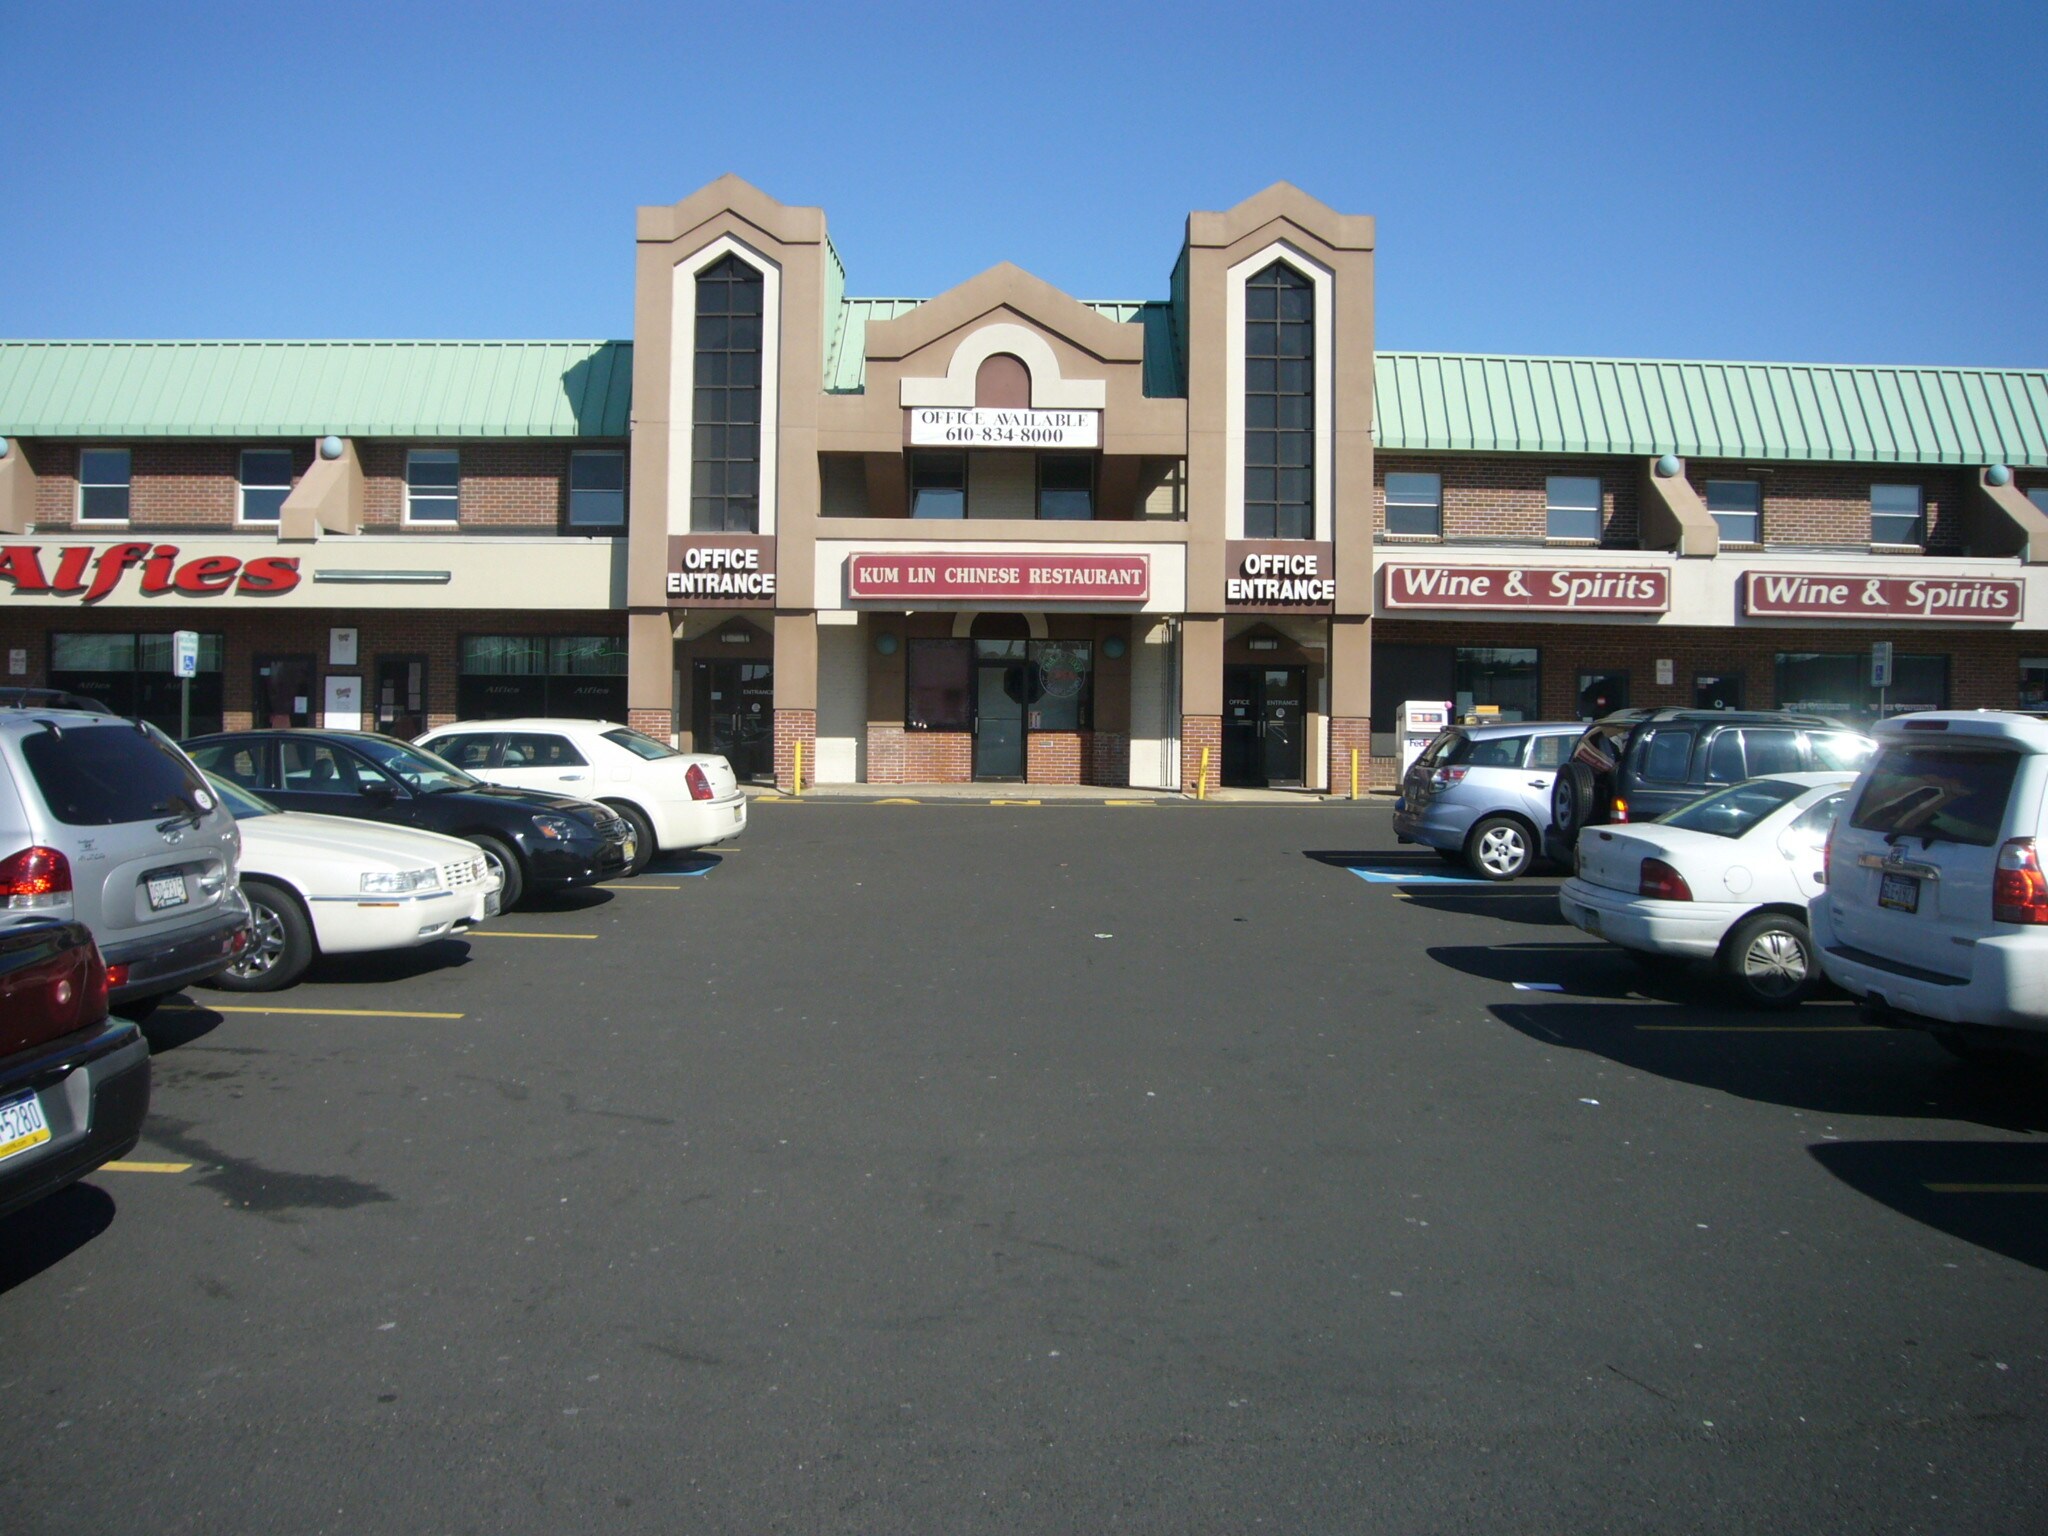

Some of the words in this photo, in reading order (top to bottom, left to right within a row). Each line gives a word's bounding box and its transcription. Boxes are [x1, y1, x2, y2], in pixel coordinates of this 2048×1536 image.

[922, 411, 986, 426] OFFICE
[993, 413, 1089, 428] AVAILABLE
[945, 427, 1064, 443] 610-834-8000
[684, 548, 759, 570] OFFICE
[1244, 553, 1318, 576] OFFICE
[0, 542, 301, 602] Alfies
[859, 566, 899, 584] KUM
[908, 567, 936, 584] LIN
[944, 567, 1020, 585] CHINESE
[1028, 568, 1143, 586] RESTAURANT
[666, 572, 777, 595] ENTRANCE
[1227, 578, 1335, 600] ENTRANCE
[1403, 569, 1491, 597] Wine
[1503, 570, 1533, 598] &
[1549, 571, 1656, 607] Spirits
[1764, 576, 1849, 604] Wine
[1861, 578, 1890, 606] &
[1905, 580, 2009, 615] Spirits
[1409, 738, 1433, 748] FedE
